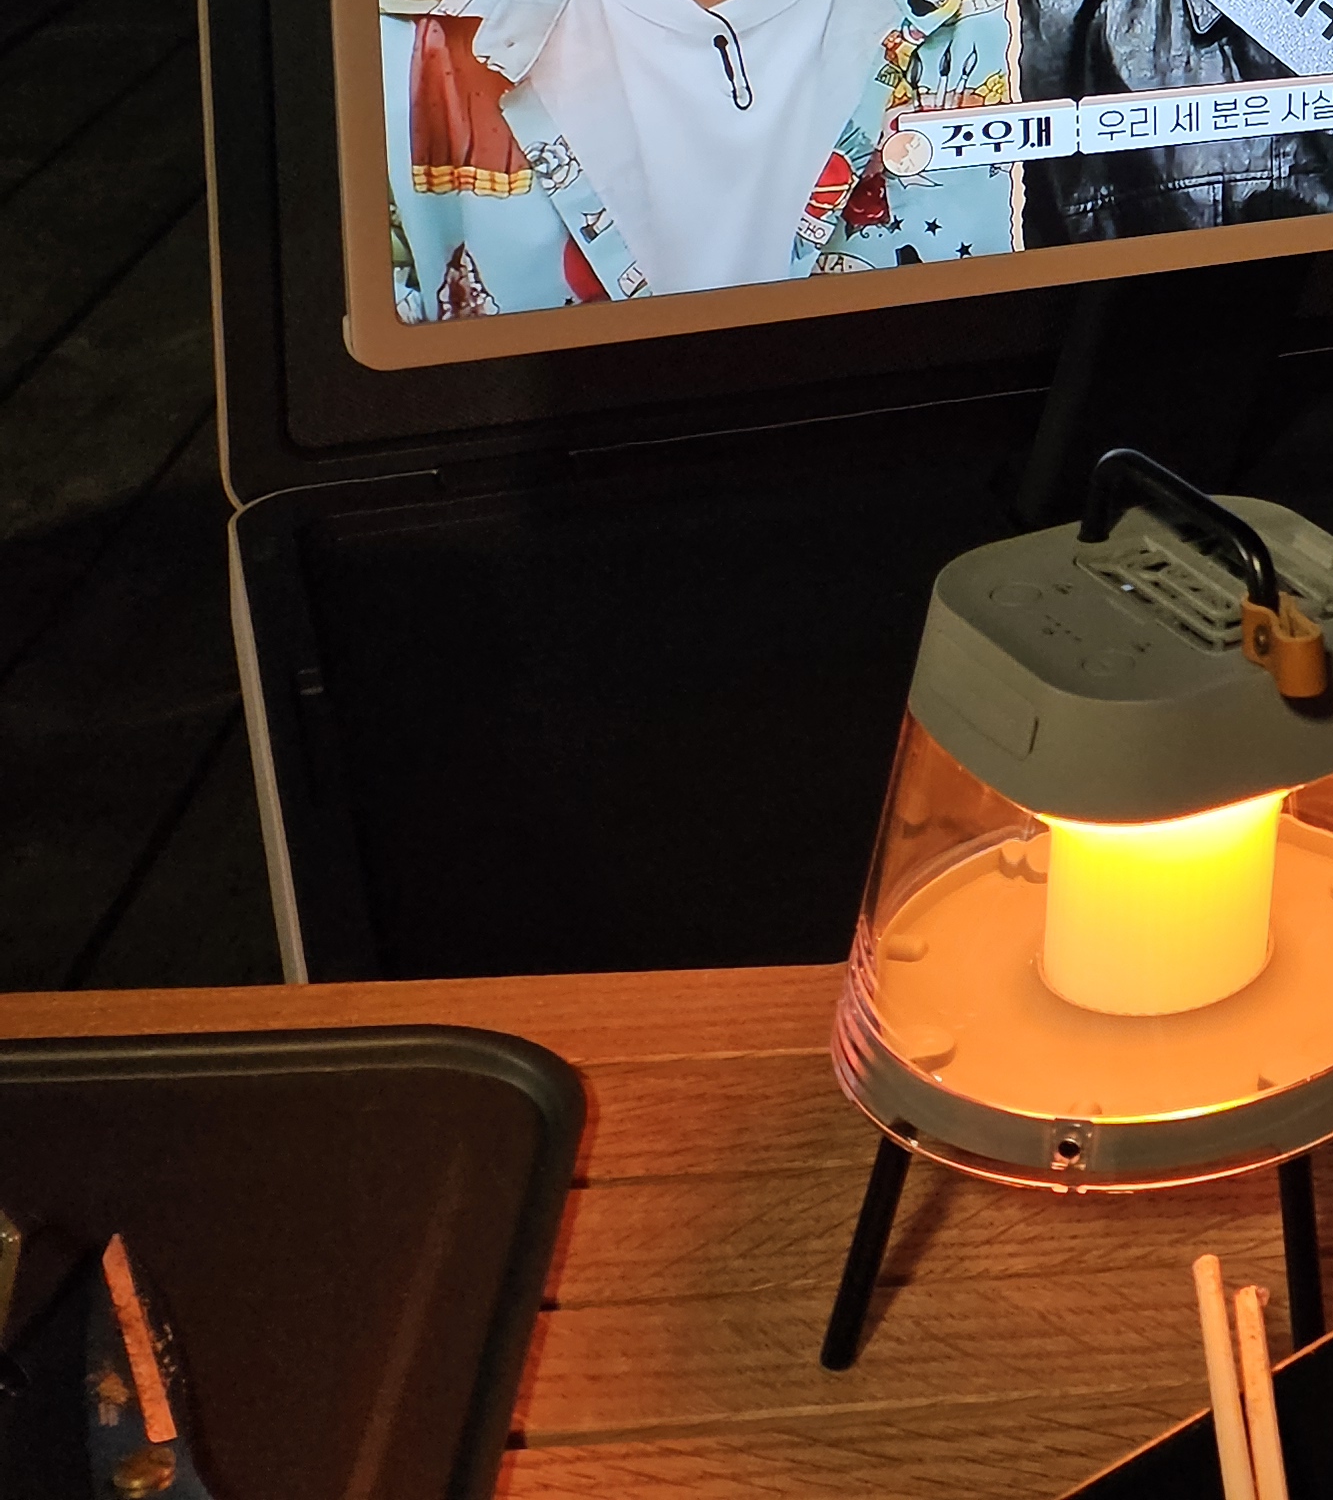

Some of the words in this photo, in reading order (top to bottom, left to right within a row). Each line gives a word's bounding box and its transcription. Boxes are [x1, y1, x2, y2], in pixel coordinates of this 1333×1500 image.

[941, 116, 1052, 157] 주우재
[1097, 105, 1158, 141] 우리
[1170, 102, 1200, 133] 세
[1211, 95, 1271, 131] 분은
